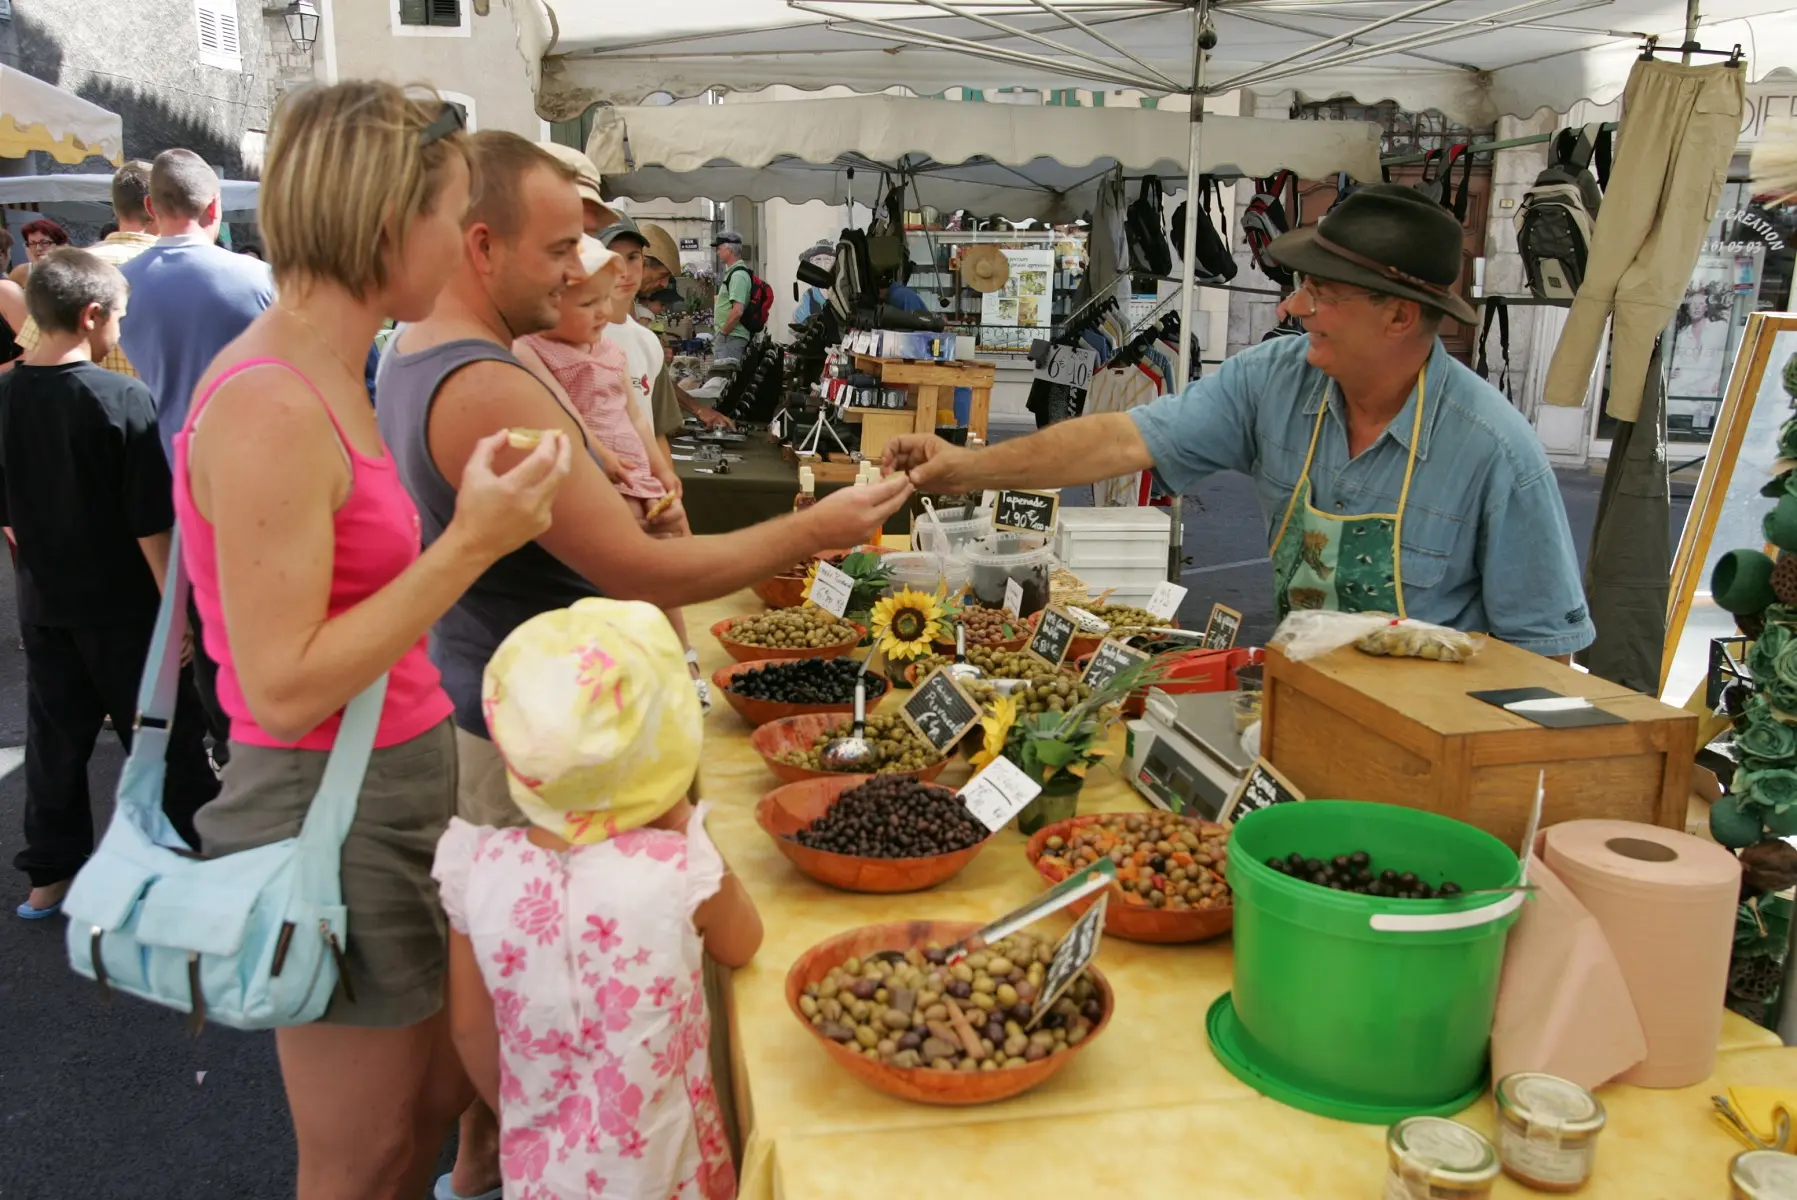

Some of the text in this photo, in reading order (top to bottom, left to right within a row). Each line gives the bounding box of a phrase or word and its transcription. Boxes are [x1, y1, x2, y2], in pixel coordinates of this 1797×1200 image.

[1725, 208, 1785, 251] CREATION
[1727, 240, 1745, 253] 05
[1746, 241, 1762, 254] 03
[1000, 490, 1048, 510] Tapenade
